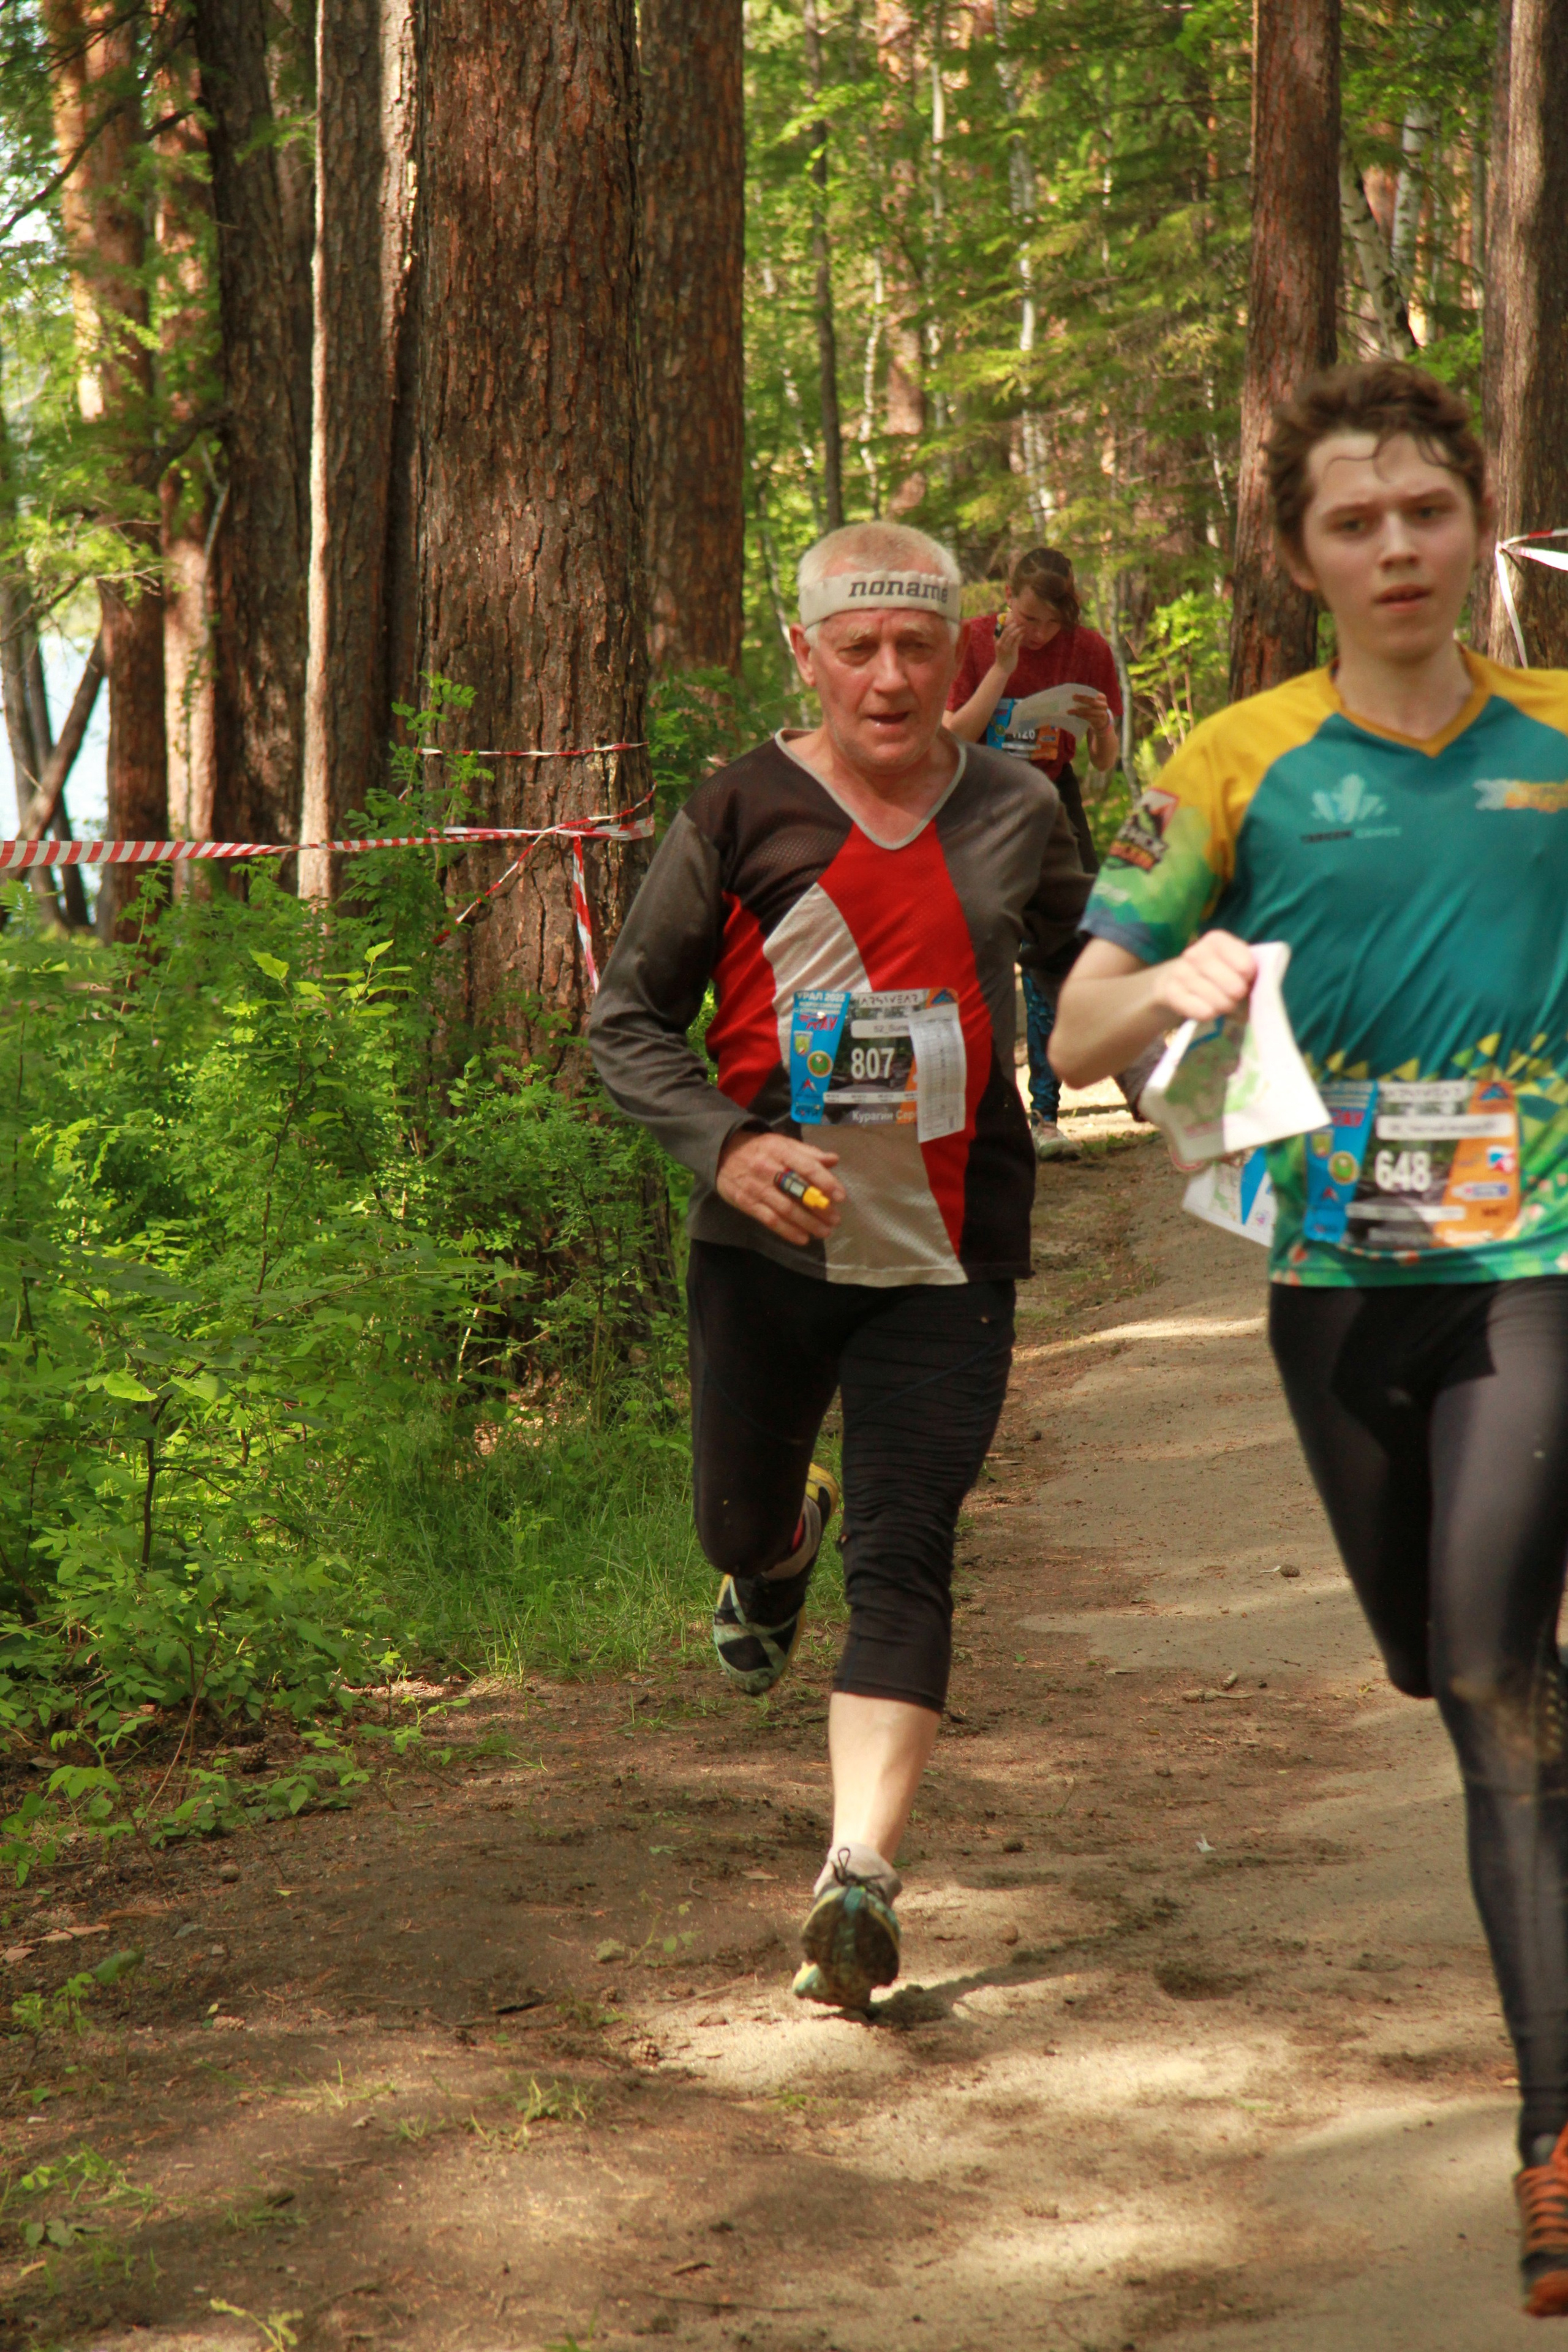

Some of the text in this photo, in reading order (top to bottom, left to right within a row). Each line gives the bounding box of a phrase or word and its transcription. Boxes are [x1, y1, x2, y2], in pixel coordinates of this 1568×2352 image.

[848, 581, 948, 602] noname
[851, 1047, 895, 1079] 807
[1375, 1150, 1432, 1192] 648
